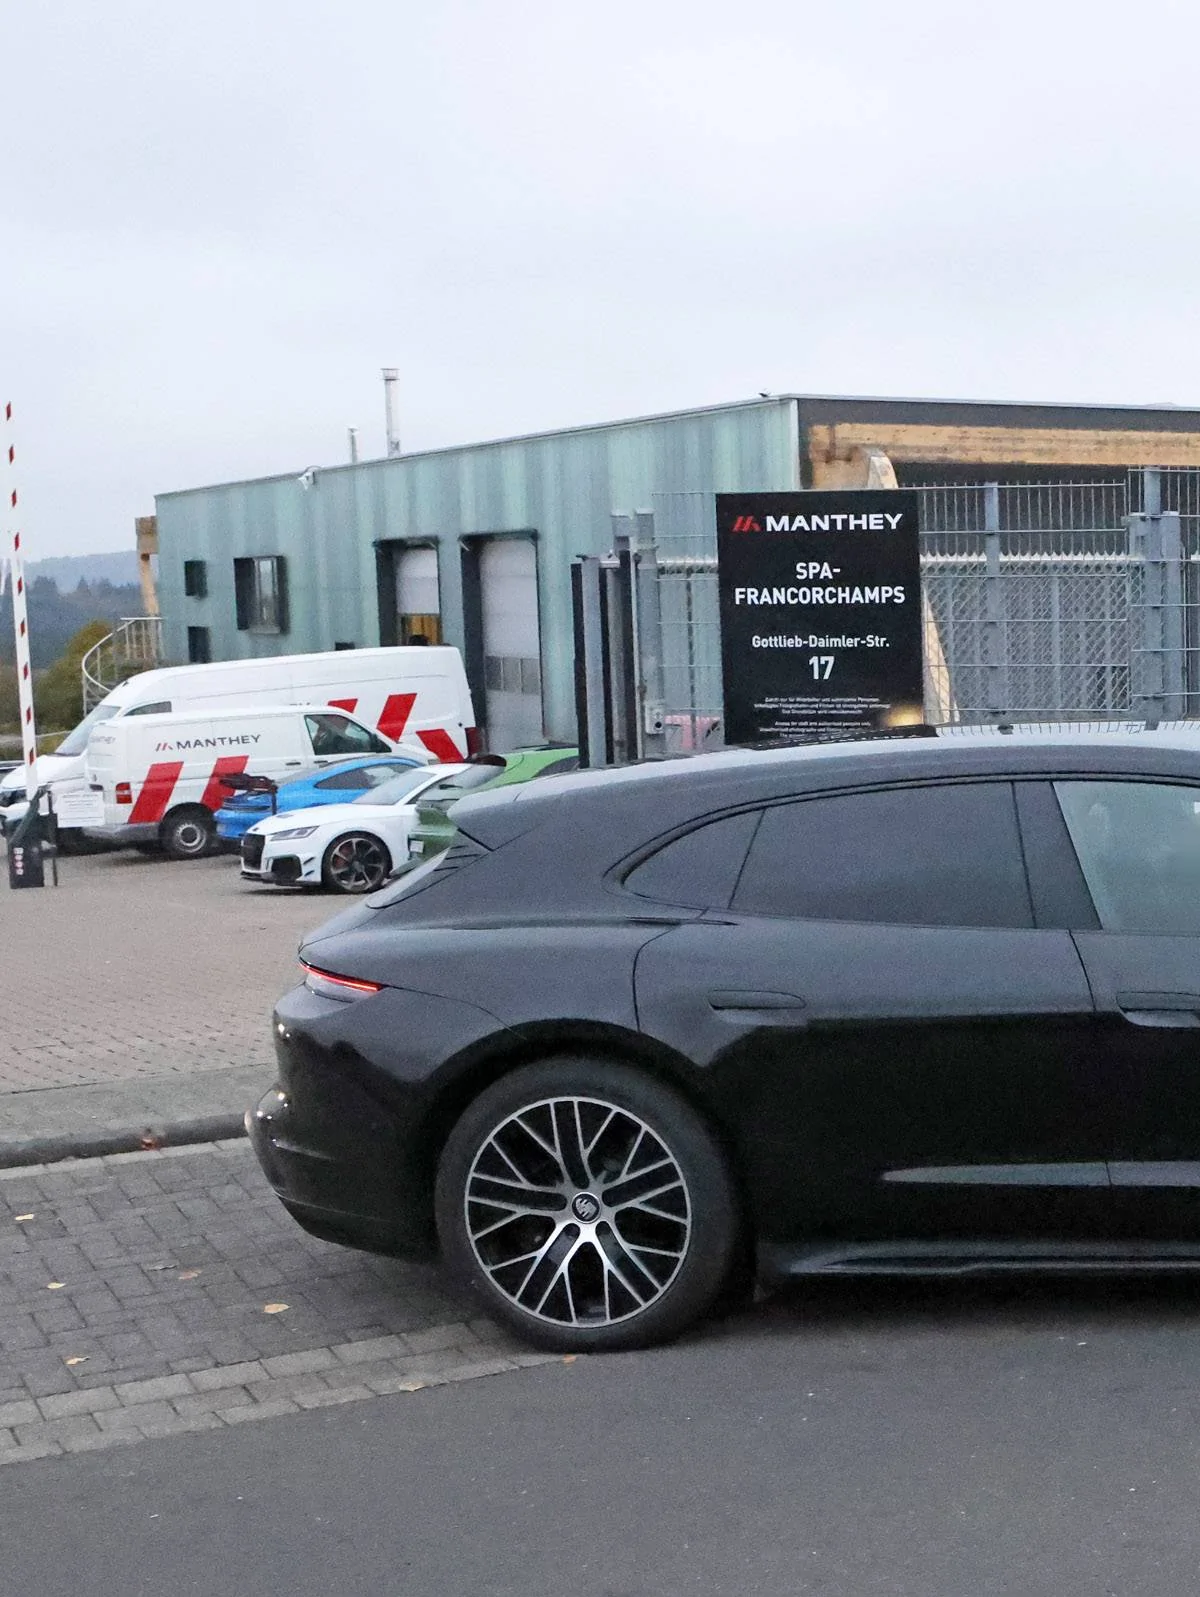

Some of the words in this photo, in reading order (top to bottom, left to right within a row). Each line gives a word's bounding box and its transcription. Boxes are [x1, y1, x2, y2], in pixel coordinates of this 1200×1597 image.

[766, 513, 903, 532] MANTHEY
[796, 562, 840, 580] SPA-
[735, 586, 905, 605] FRANCORCHAMPS
[752, 635, 890, 649] Gottlieb-Daimler-Str.
[809, 656, 835, 680] 17
[176, 734, 261, 750] MANTHEY
